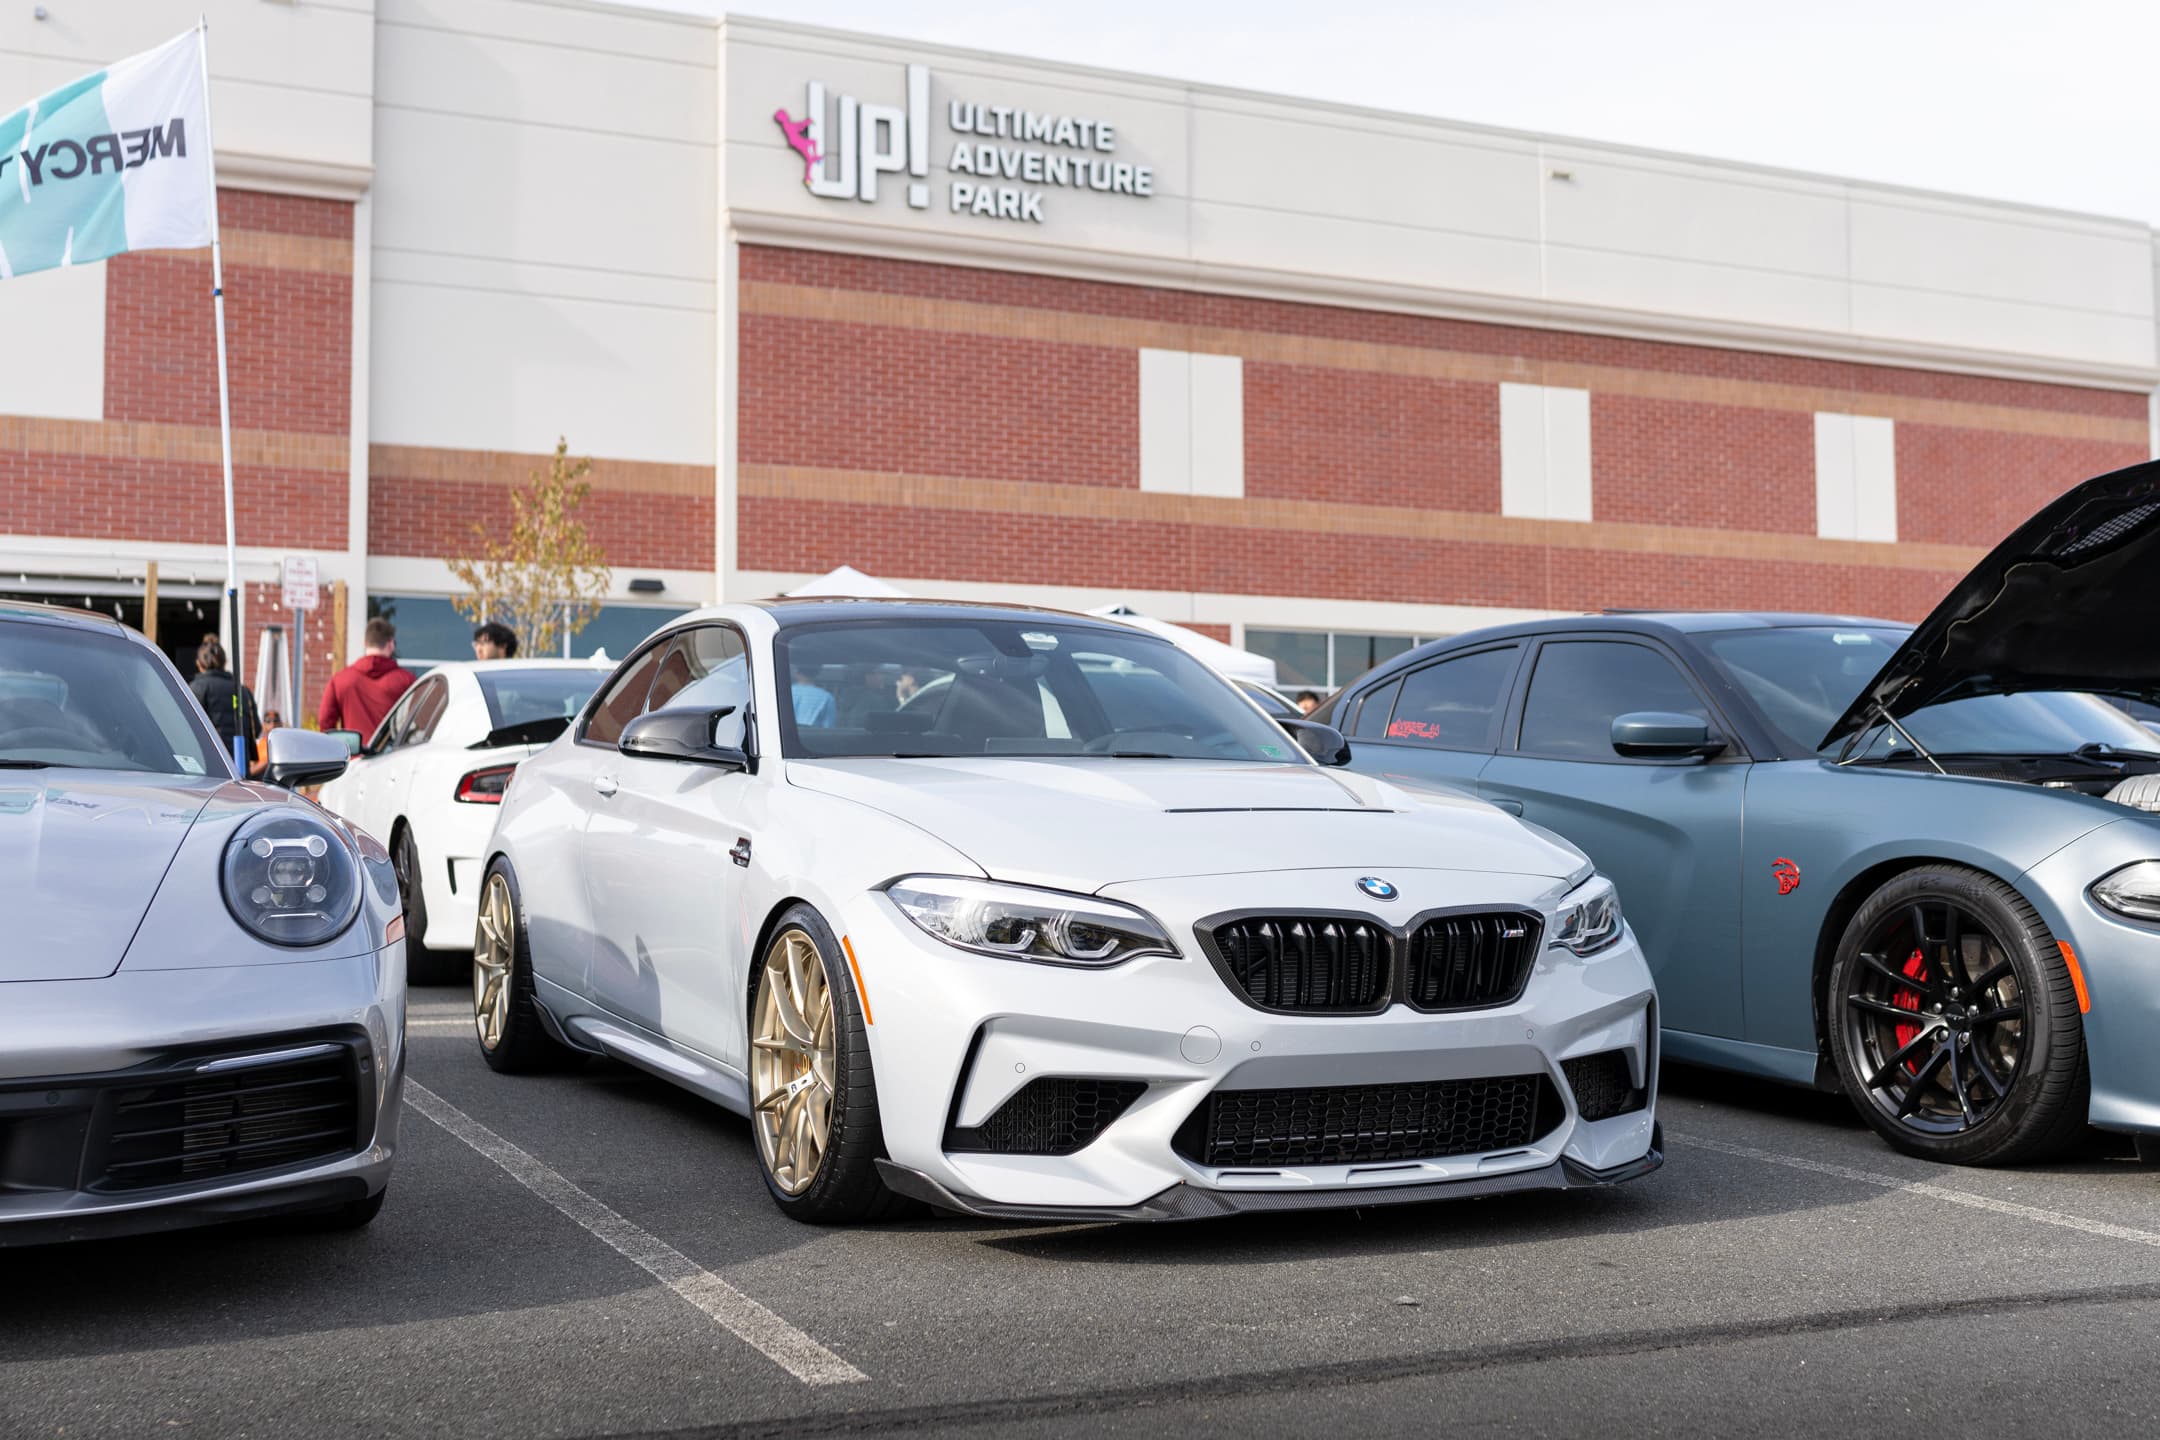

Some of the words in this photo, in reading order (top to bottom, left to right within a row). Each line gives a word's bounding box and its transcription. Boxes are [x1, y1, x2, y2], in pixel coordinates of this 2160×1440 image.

[949, 100, 1116, 152] ULTIMATE
[949, 141, 1153, 197] ADVENTURE
[950, 181, 1044, 223] PARK
